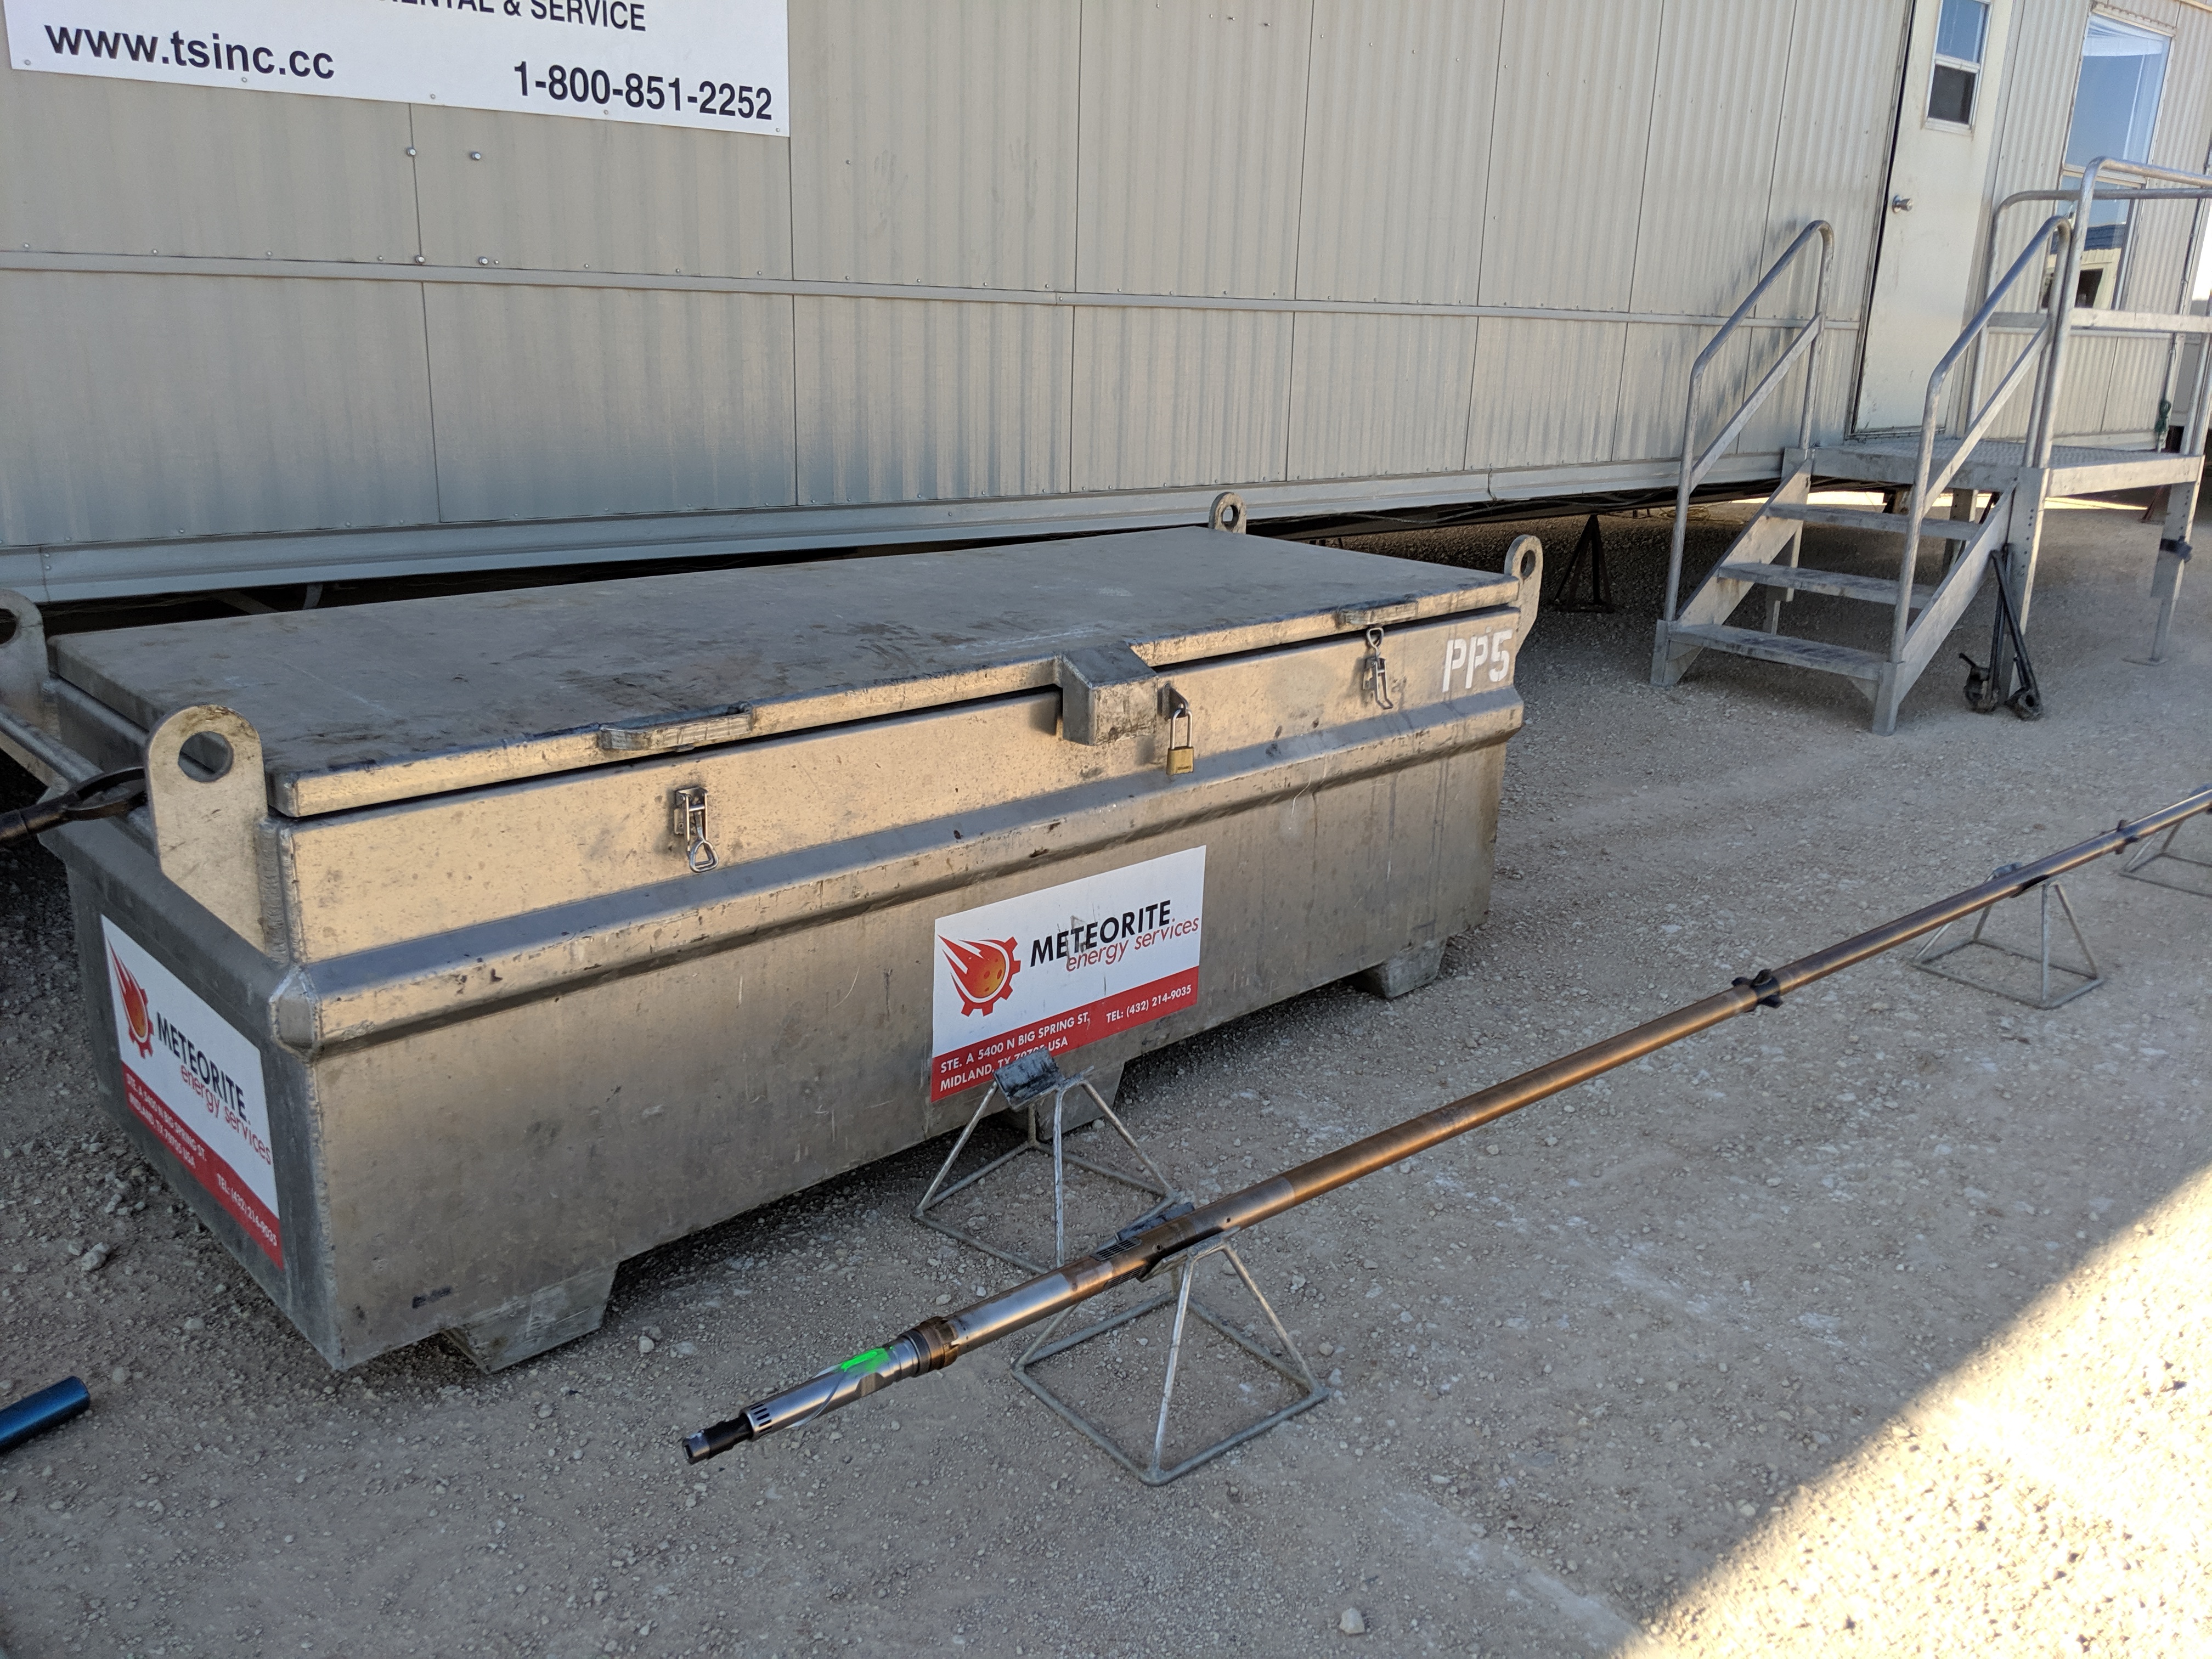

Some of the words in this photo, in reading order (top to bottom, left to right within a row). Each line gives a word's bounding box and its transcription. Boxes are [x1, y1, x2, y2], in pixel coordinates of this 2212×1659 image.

[530, 0, 646, 31] SERVICE
[44, 25, 335, 79] www.tsinc.cc
[514, 60, 772, 120] 1-800-851-2252
[1442, 629, 1513, 692] PP5
[1030, 899, 1171, 968] METEORITE
[1065, 939, 1130, 972] energy
[1134, 917, 1200, 950] services
[1106, 1009, 1124, 1023] TEL:
[1126, 999, 1149, 1018] (432)
[1152, 984, 1192, 1007] 214-9035
[156, 1011, 247, 1122] METEORITE
[940, 1057, 962, 1074] STE.
[966, 1052, 974, 1065] A
[978, 1042, 1004, 1060] 5400
[1007, 1037, 1015, 1049] N
[1018, 1031, 1036, 1046] BIG
[1038, 1017, 1075, 1039] SPRING
[1048, 1036, 1068, 1052] USA
[180, 1064, 221, 1119] energy
[224, 1105, 272, 1165] services
